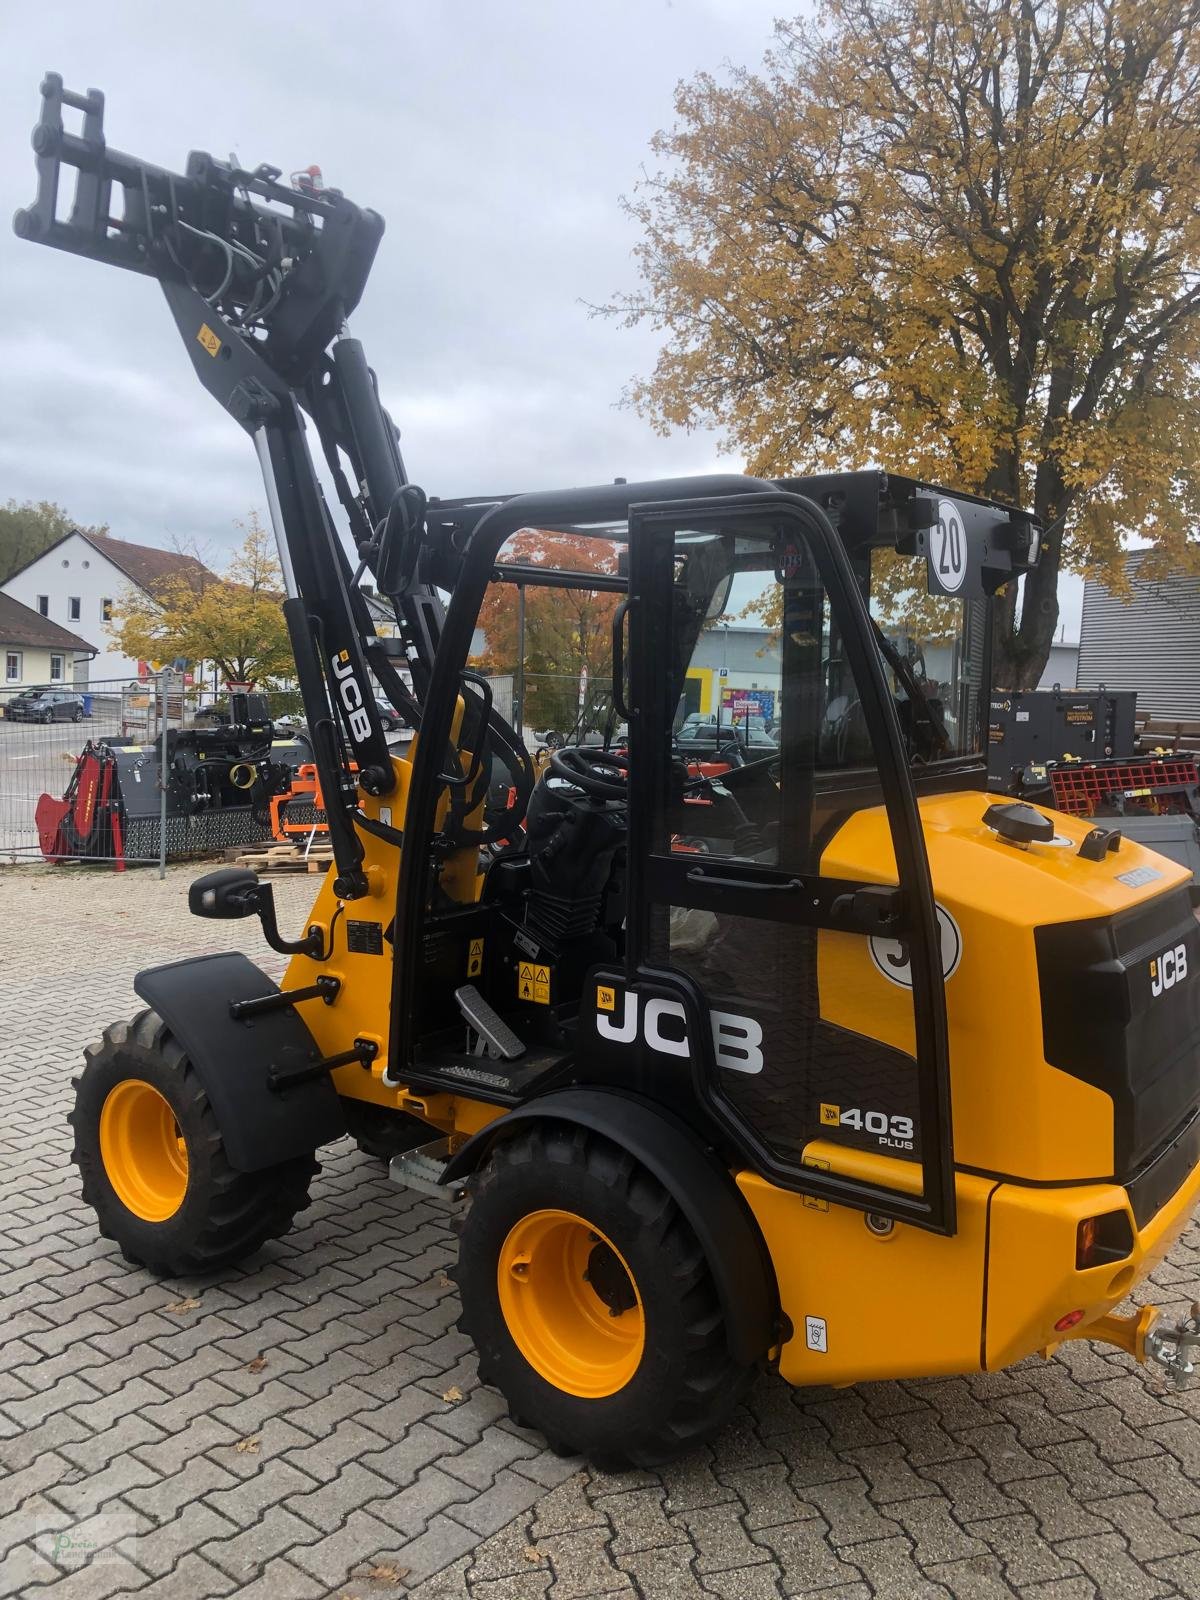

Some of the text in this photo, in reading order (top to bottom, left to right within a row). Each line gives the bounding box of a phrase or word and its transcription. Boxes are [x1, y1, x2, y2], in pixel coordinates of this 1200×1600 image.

[937, 517, 961, 574] 20
[331, 653, 372, 743] JCB
[1151, 943, 1188, 997] JCB
[596, 991, 764, 1075] JCB
[839, 1108, 914, 1139] 403
[878, 1136, 914, 1150] PLUS
